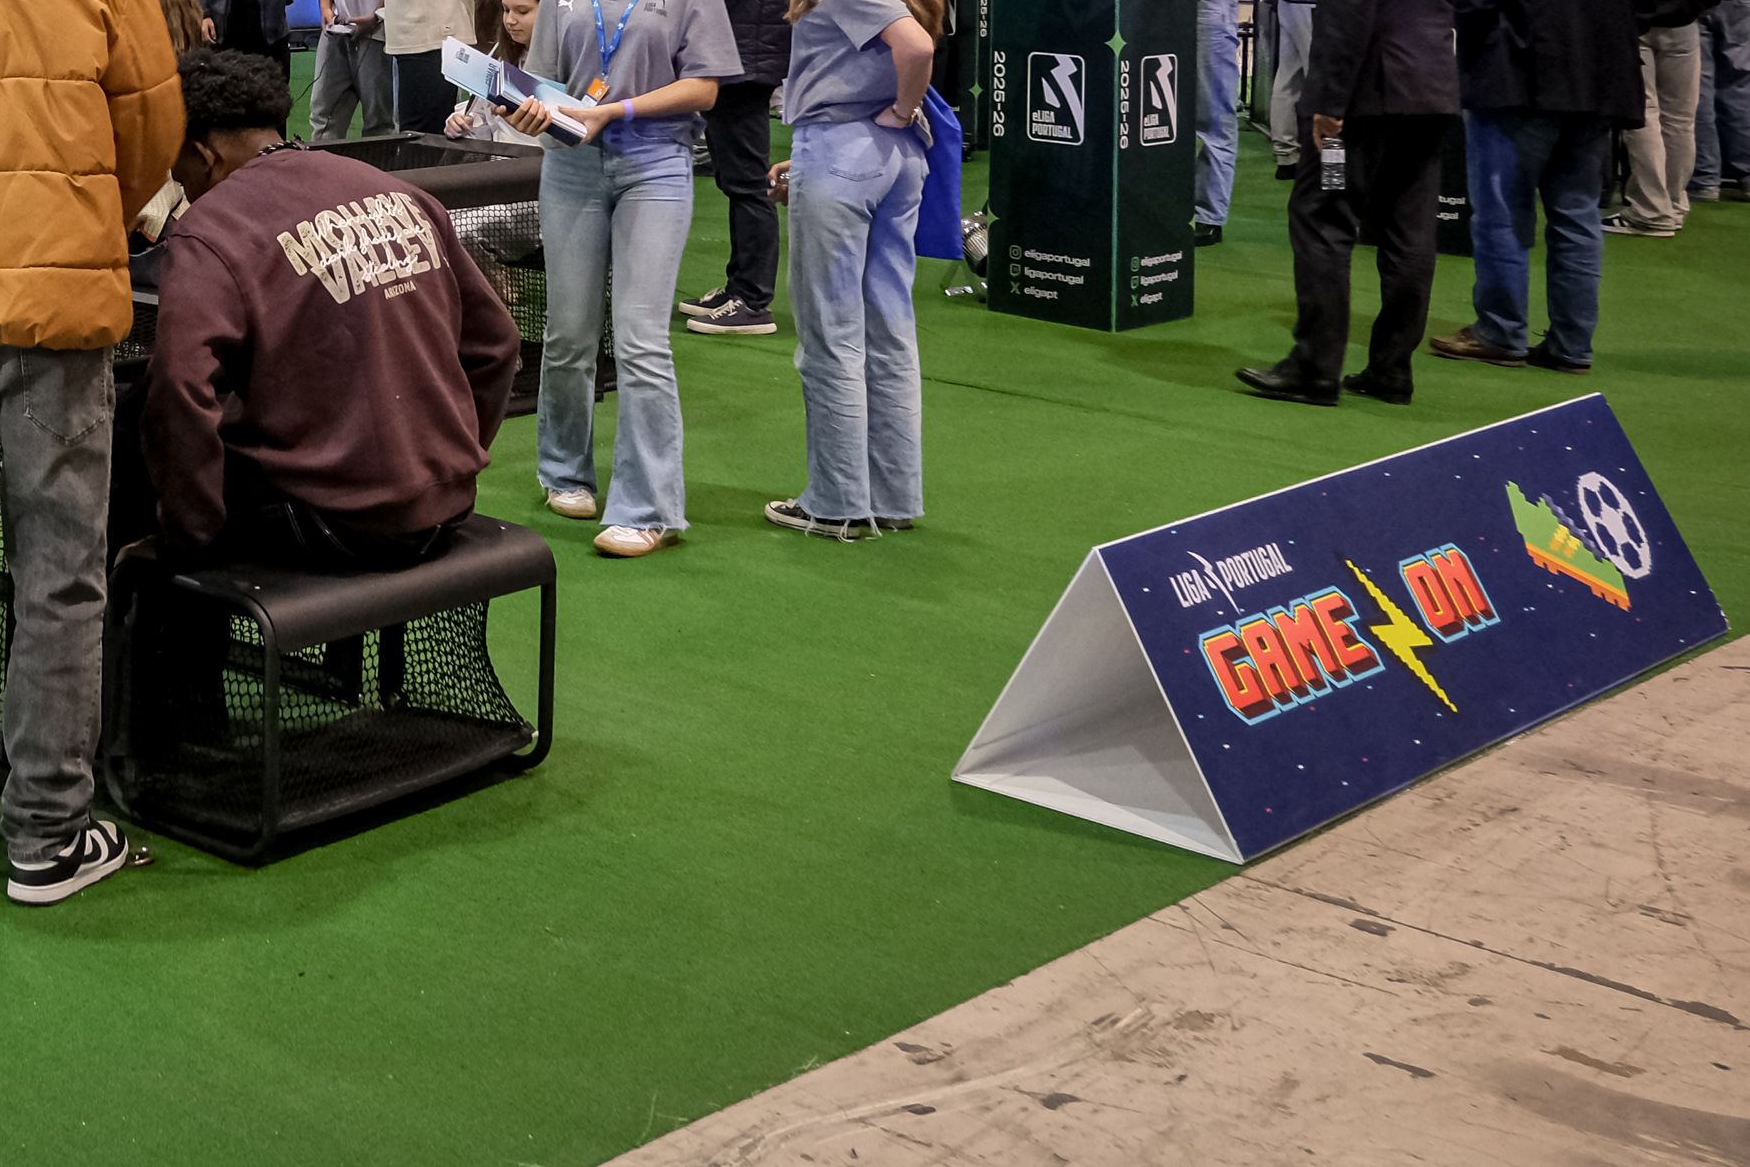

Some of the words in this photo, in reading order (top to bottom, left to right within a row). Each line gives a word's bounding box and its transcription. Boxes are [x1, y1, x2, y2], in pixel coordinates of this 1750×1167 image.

[992, 50, 1006, 137] 2025-26
[1118, 60, 1130, 149] 2025-26
[1024, 249, 1091, 268] eligaportugal
[1024, 266, 1084, 286] ligaportugal
[384, 280, 417, 300] ARIZONA
[1024, 286, 1059, 301] eligapt
[1168, 562, 1212, 609] LIGA
[1216, 542, 1293, 592] PORTUGAL
[1199, 586, 1386, 726] GAME
[1399, 542, 1501, 644] ON
